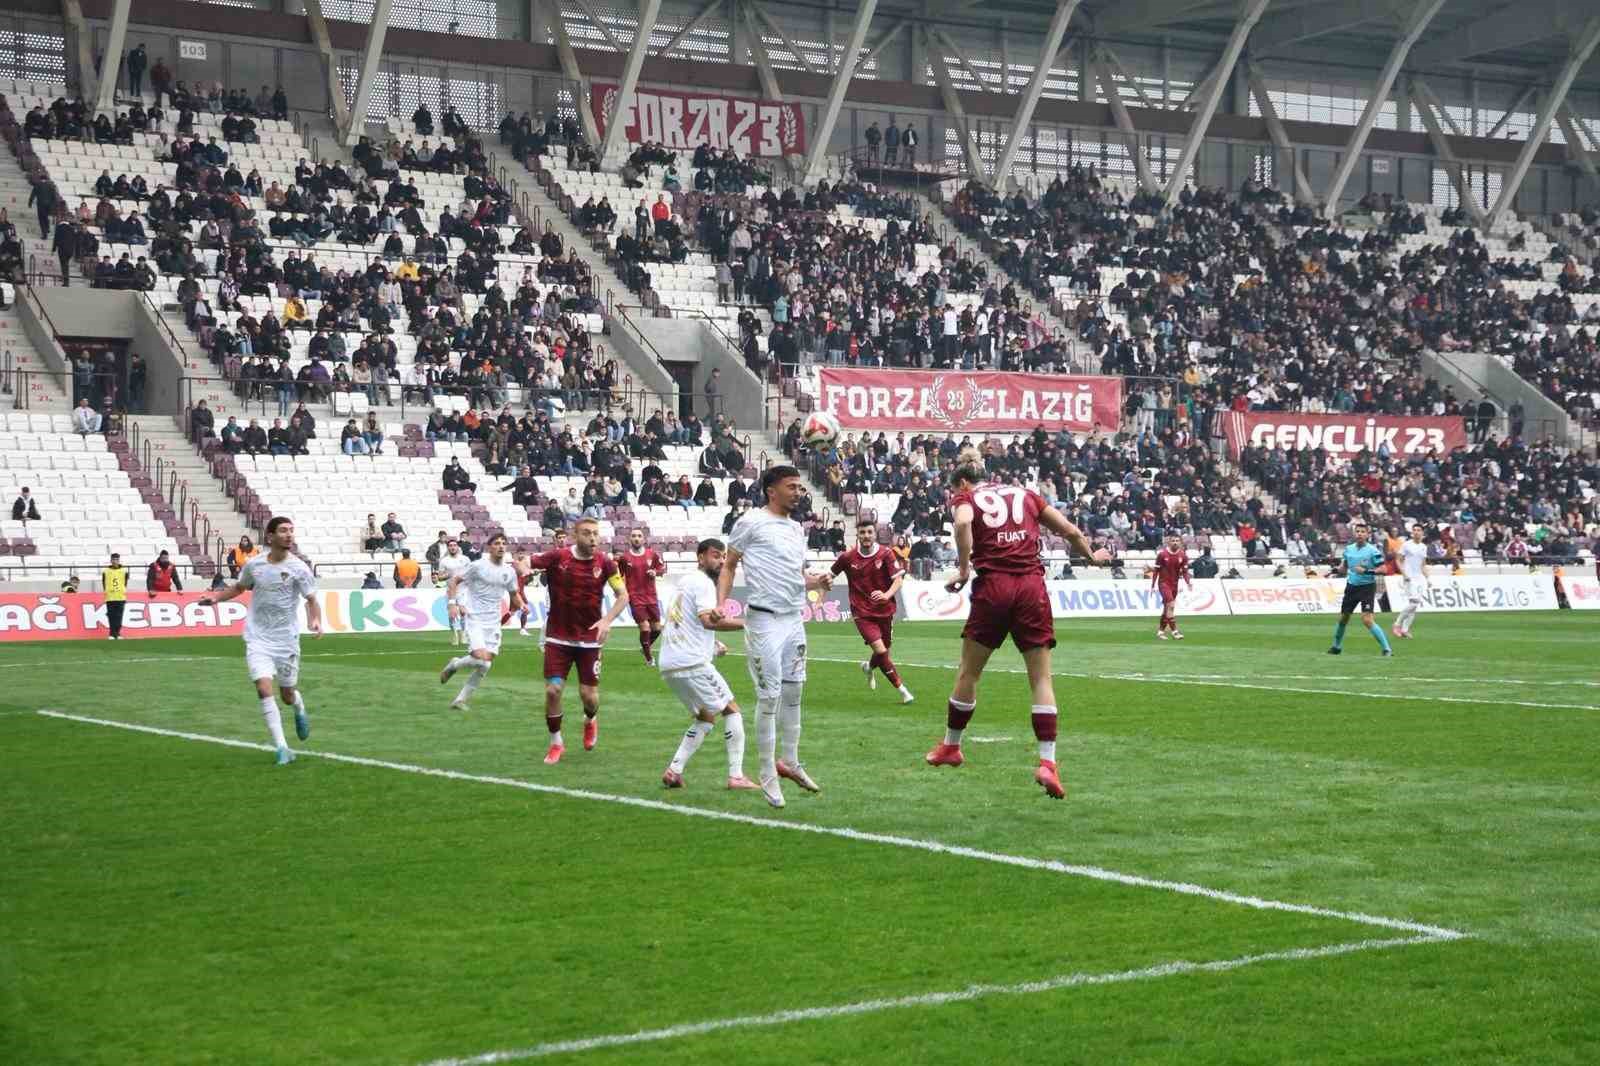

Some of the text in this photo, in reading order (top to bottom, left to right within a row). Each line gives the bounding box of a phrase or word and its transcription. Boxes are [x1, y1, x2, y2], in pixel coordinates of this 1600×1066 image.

[731, 101, 782, 156] 23
[825, 384, 1093, 422] FORZA 23 ELAZIĞ
[1405, 428, 1444, 453] 23
[973, 487, 1026, 528] 97
[997, 530, 1027, 543] FUAT
[0, 596, 248, 631] AĞ KEBAP
